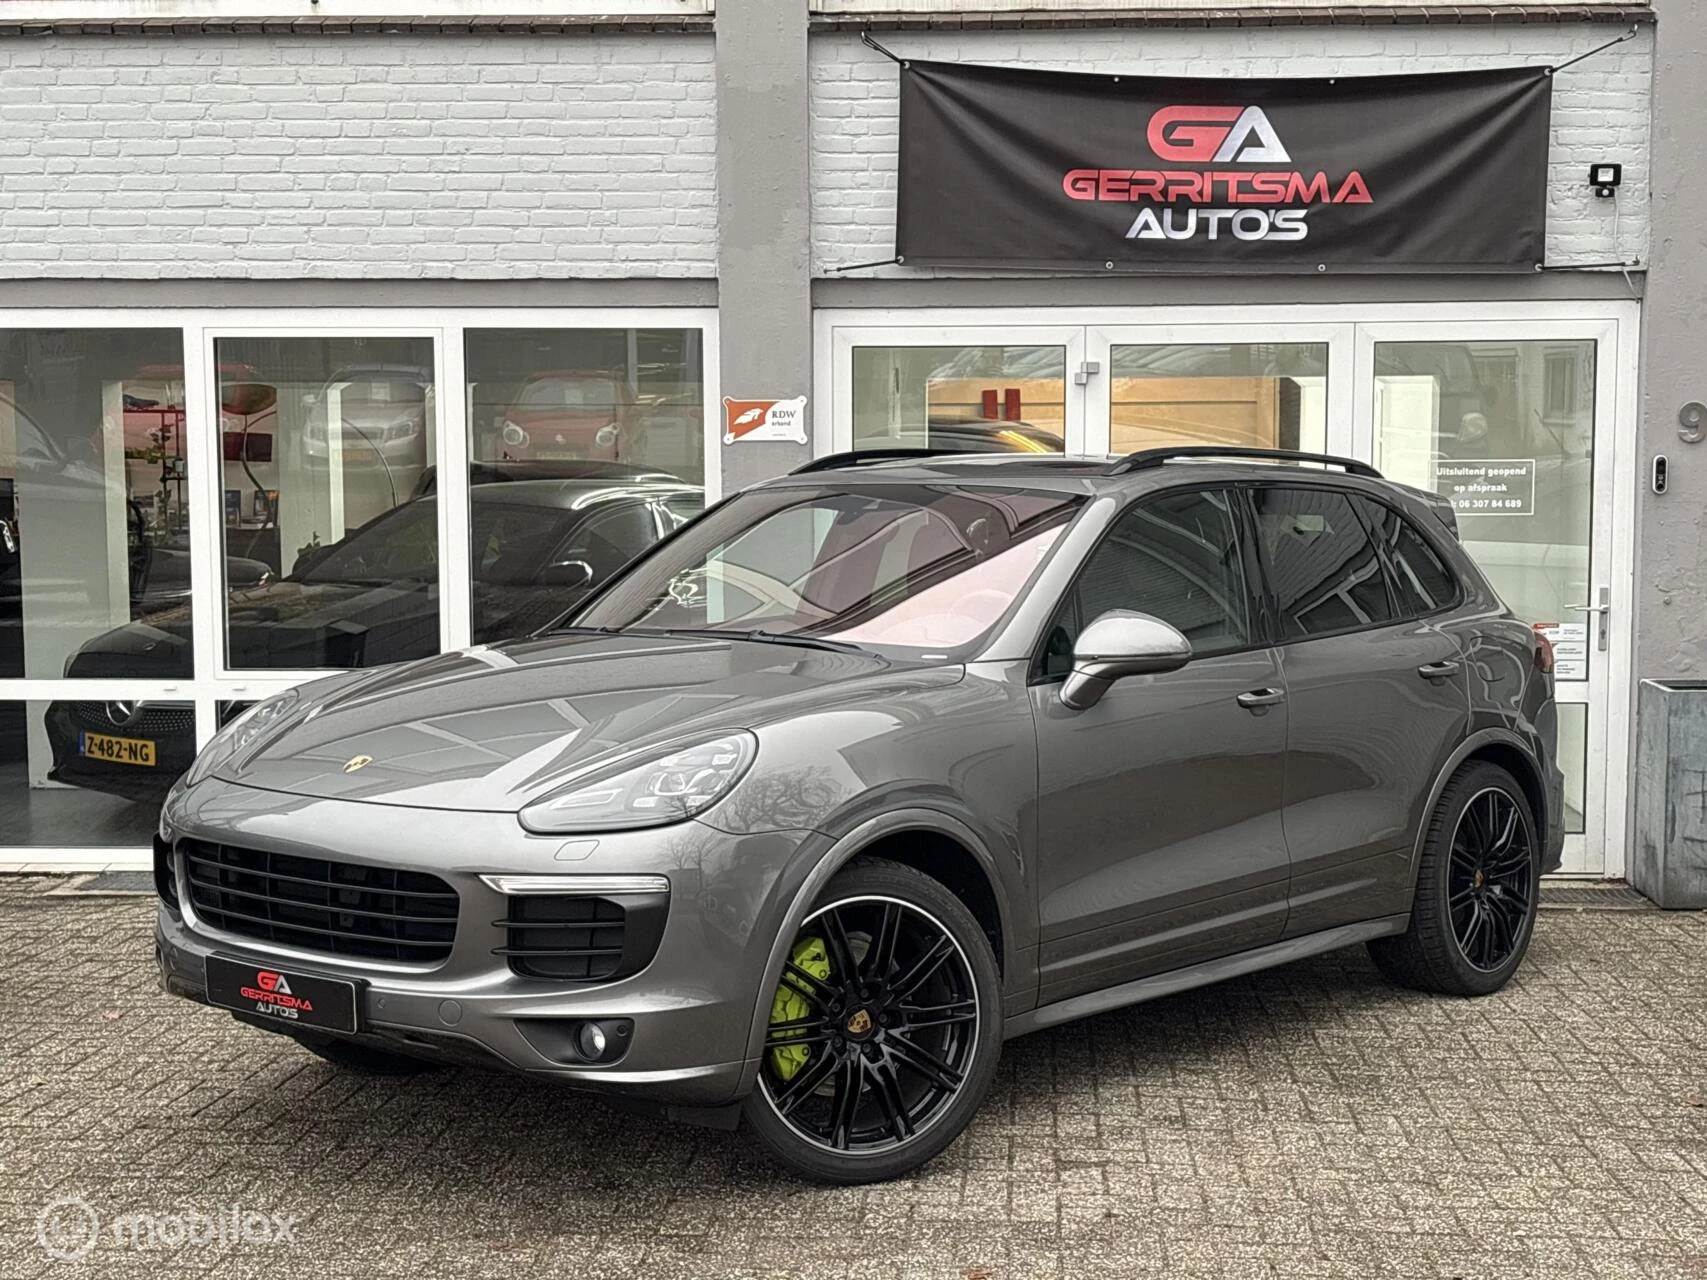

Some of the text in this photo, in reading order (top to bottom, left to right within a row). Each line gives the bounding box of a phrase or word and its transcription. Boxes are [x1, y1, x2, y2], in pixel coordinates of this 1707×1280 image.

[1147, 105, 1292, 162] GA
[1062, 169, 1374, 204] GERRITSMA
[1125, 207, 1308, 241] AUTO'S
[771, 410, 797, 419] RDW
[1678, 400, 1707, 444] 9
[1436, 467, 1527, 477] Uitsluitend geopend
[1453, 483, 1508, 494] op afspraak
[1458, 500, 1470, 508] 06
[1472, 500, 1490, 508] 307
[1505, 500, 1522, 508] 689
[87, 735, 150, 762] Z-482-NG
[257, 971, 292, 995] GA
[240, 986, 313, 1011] GERRITSMA
